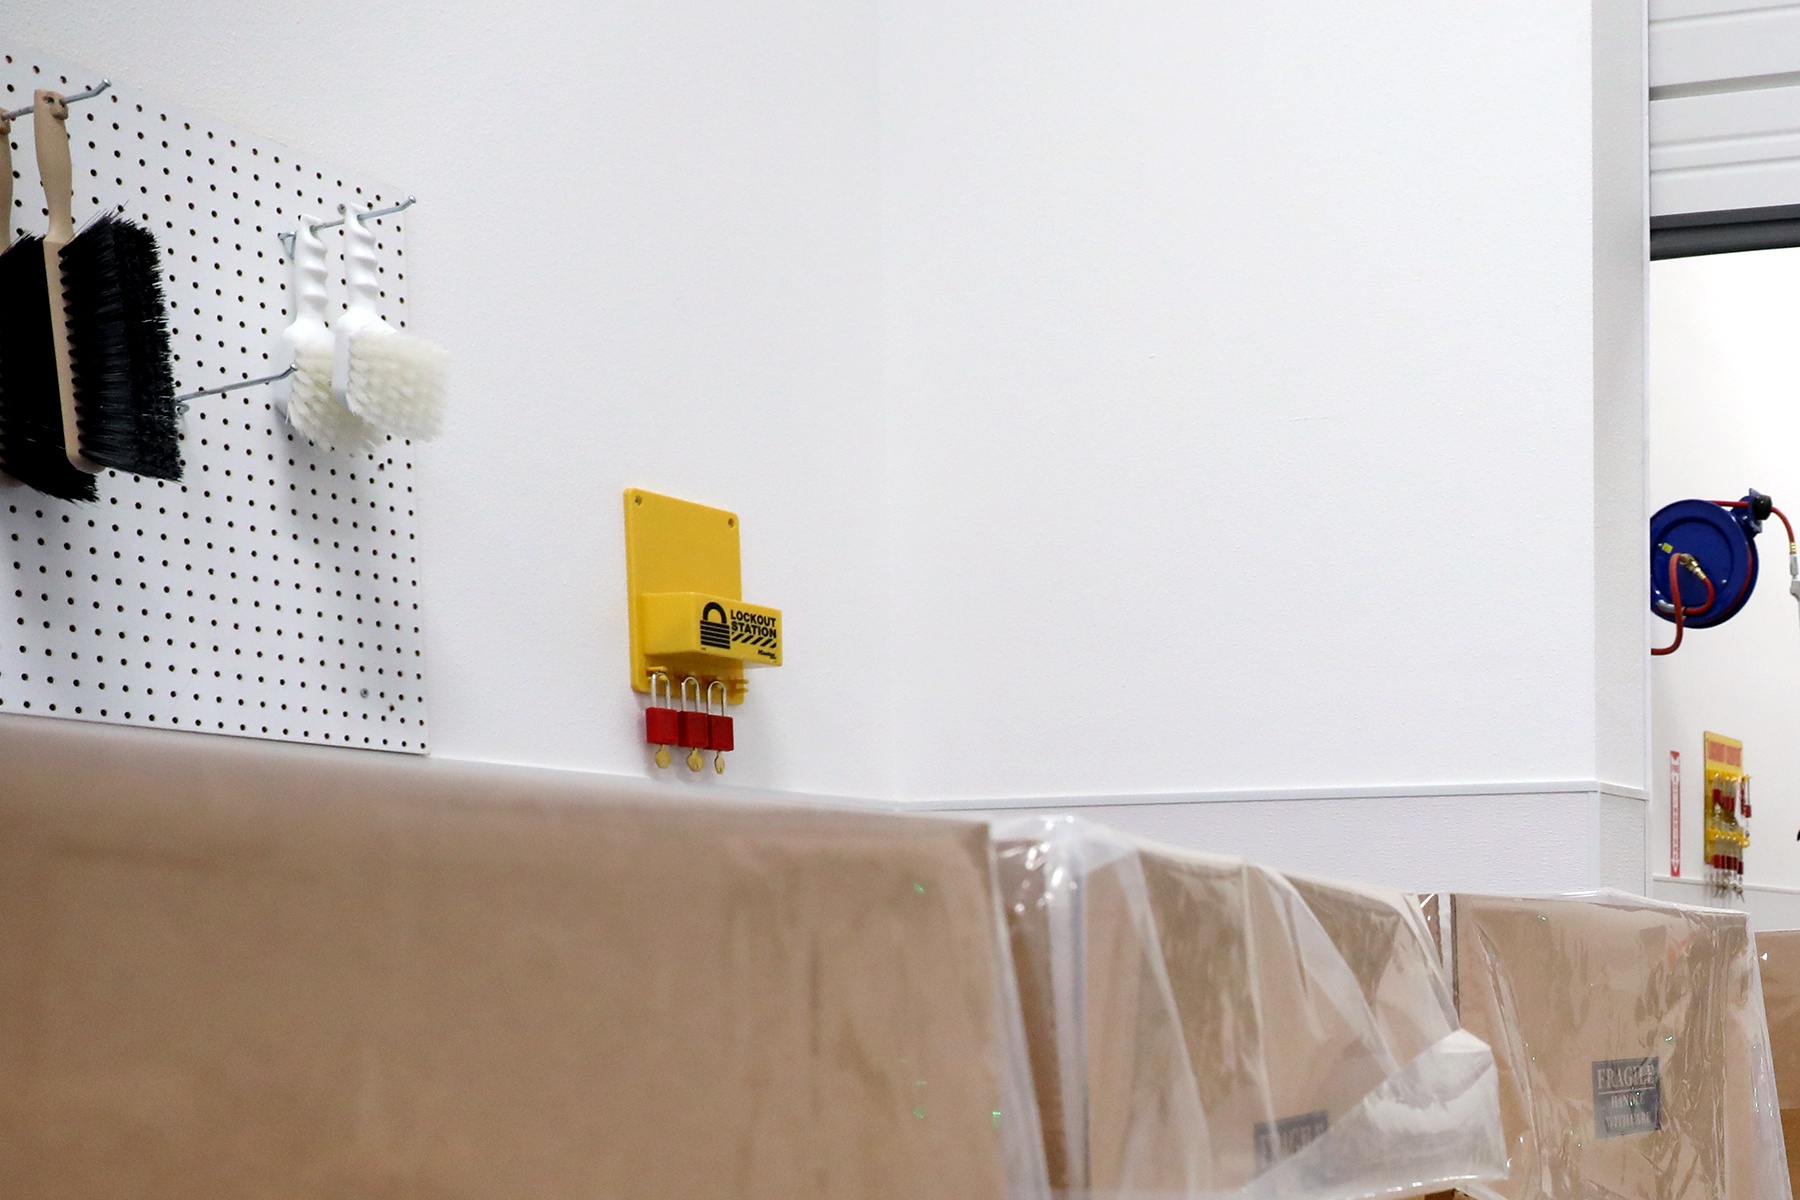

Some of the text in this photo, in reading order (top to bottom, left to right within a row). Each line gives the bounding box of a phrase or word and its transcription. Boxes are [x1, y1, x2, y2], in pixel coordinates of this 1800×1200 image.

[731, 609, 777, 627] LOCKOUT
[731, 621, 777, 638] STATION
[1597, 1065, 1655, 1089] FRAGILE
